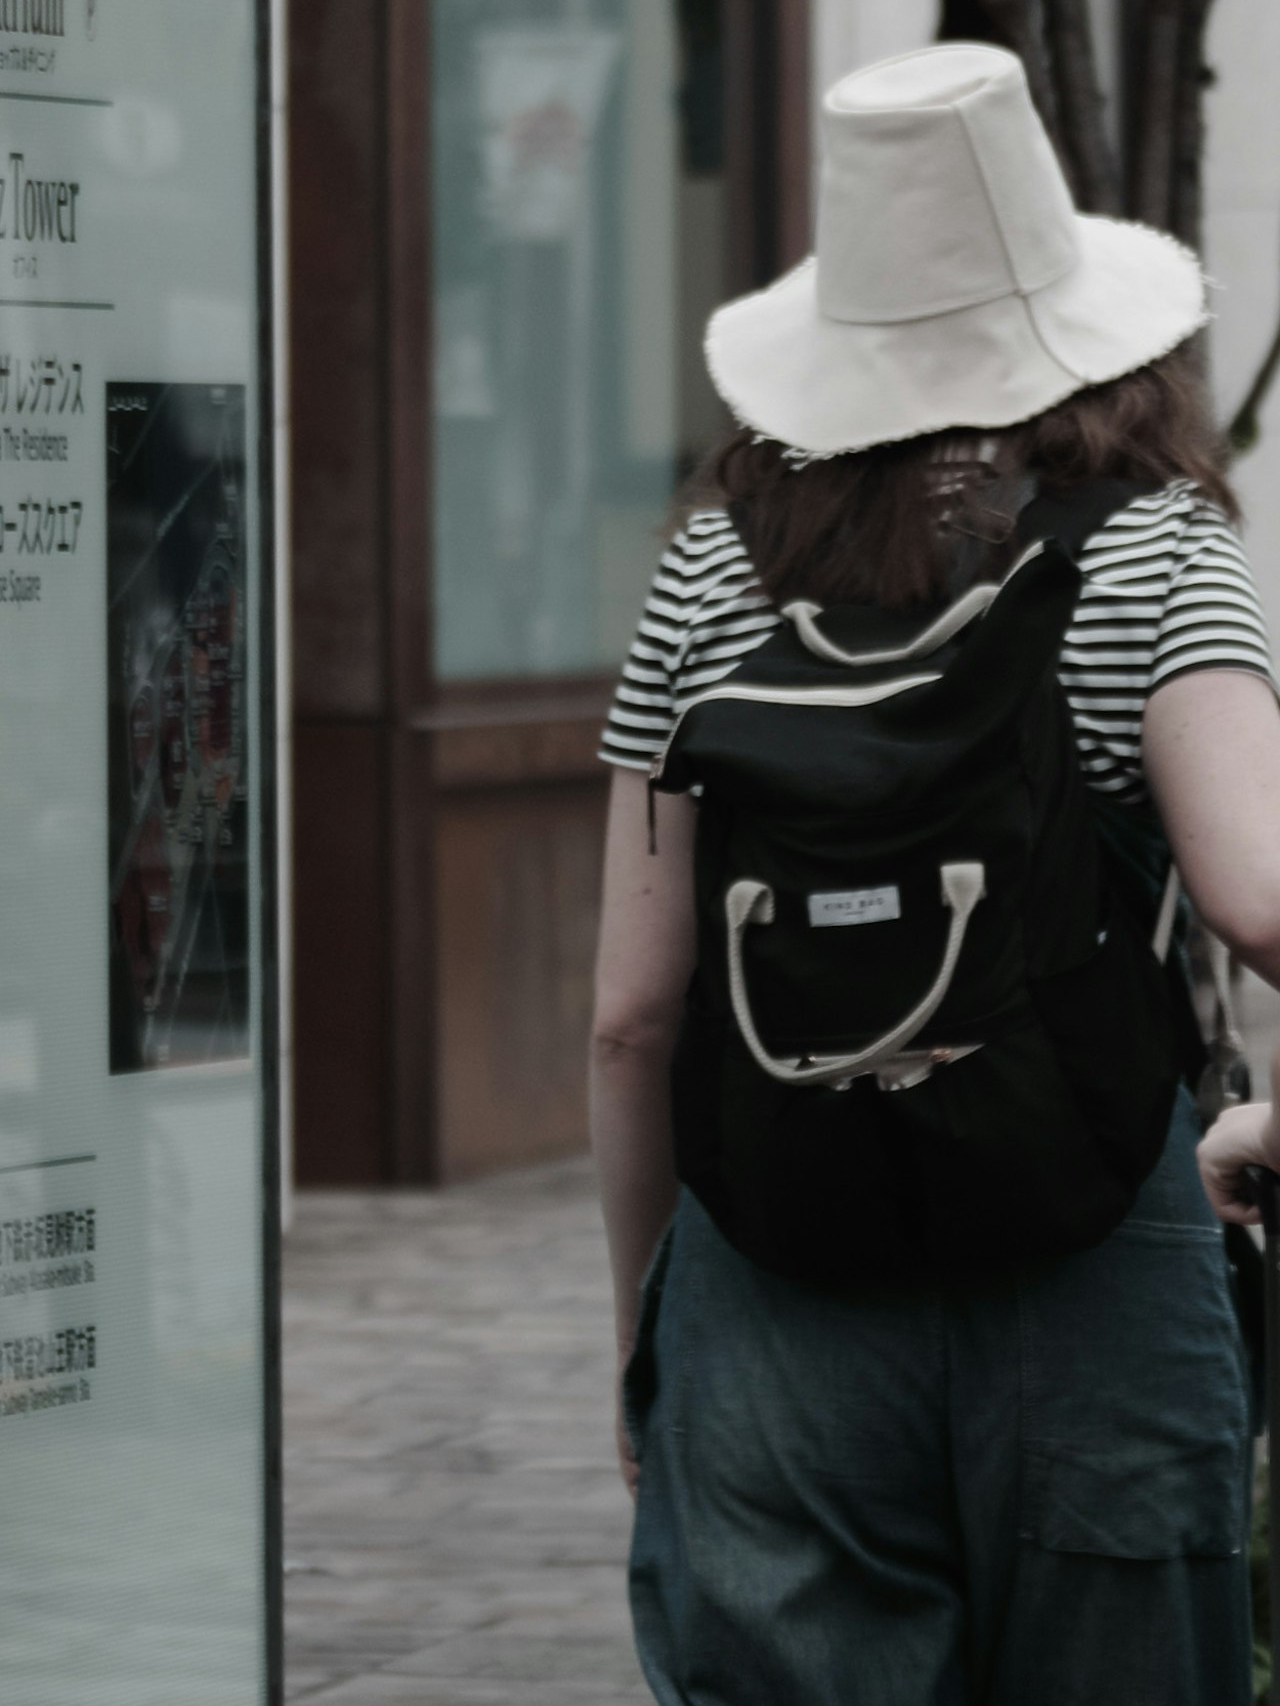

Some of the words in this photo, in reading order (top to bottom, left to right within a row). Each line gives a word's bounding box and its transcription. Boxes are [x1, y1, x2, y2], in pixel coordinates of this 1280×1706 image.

[10, 153, 79, 243] Tower
[3, 427, 20, 461] The
[23, 428, 68, 461] Residence
